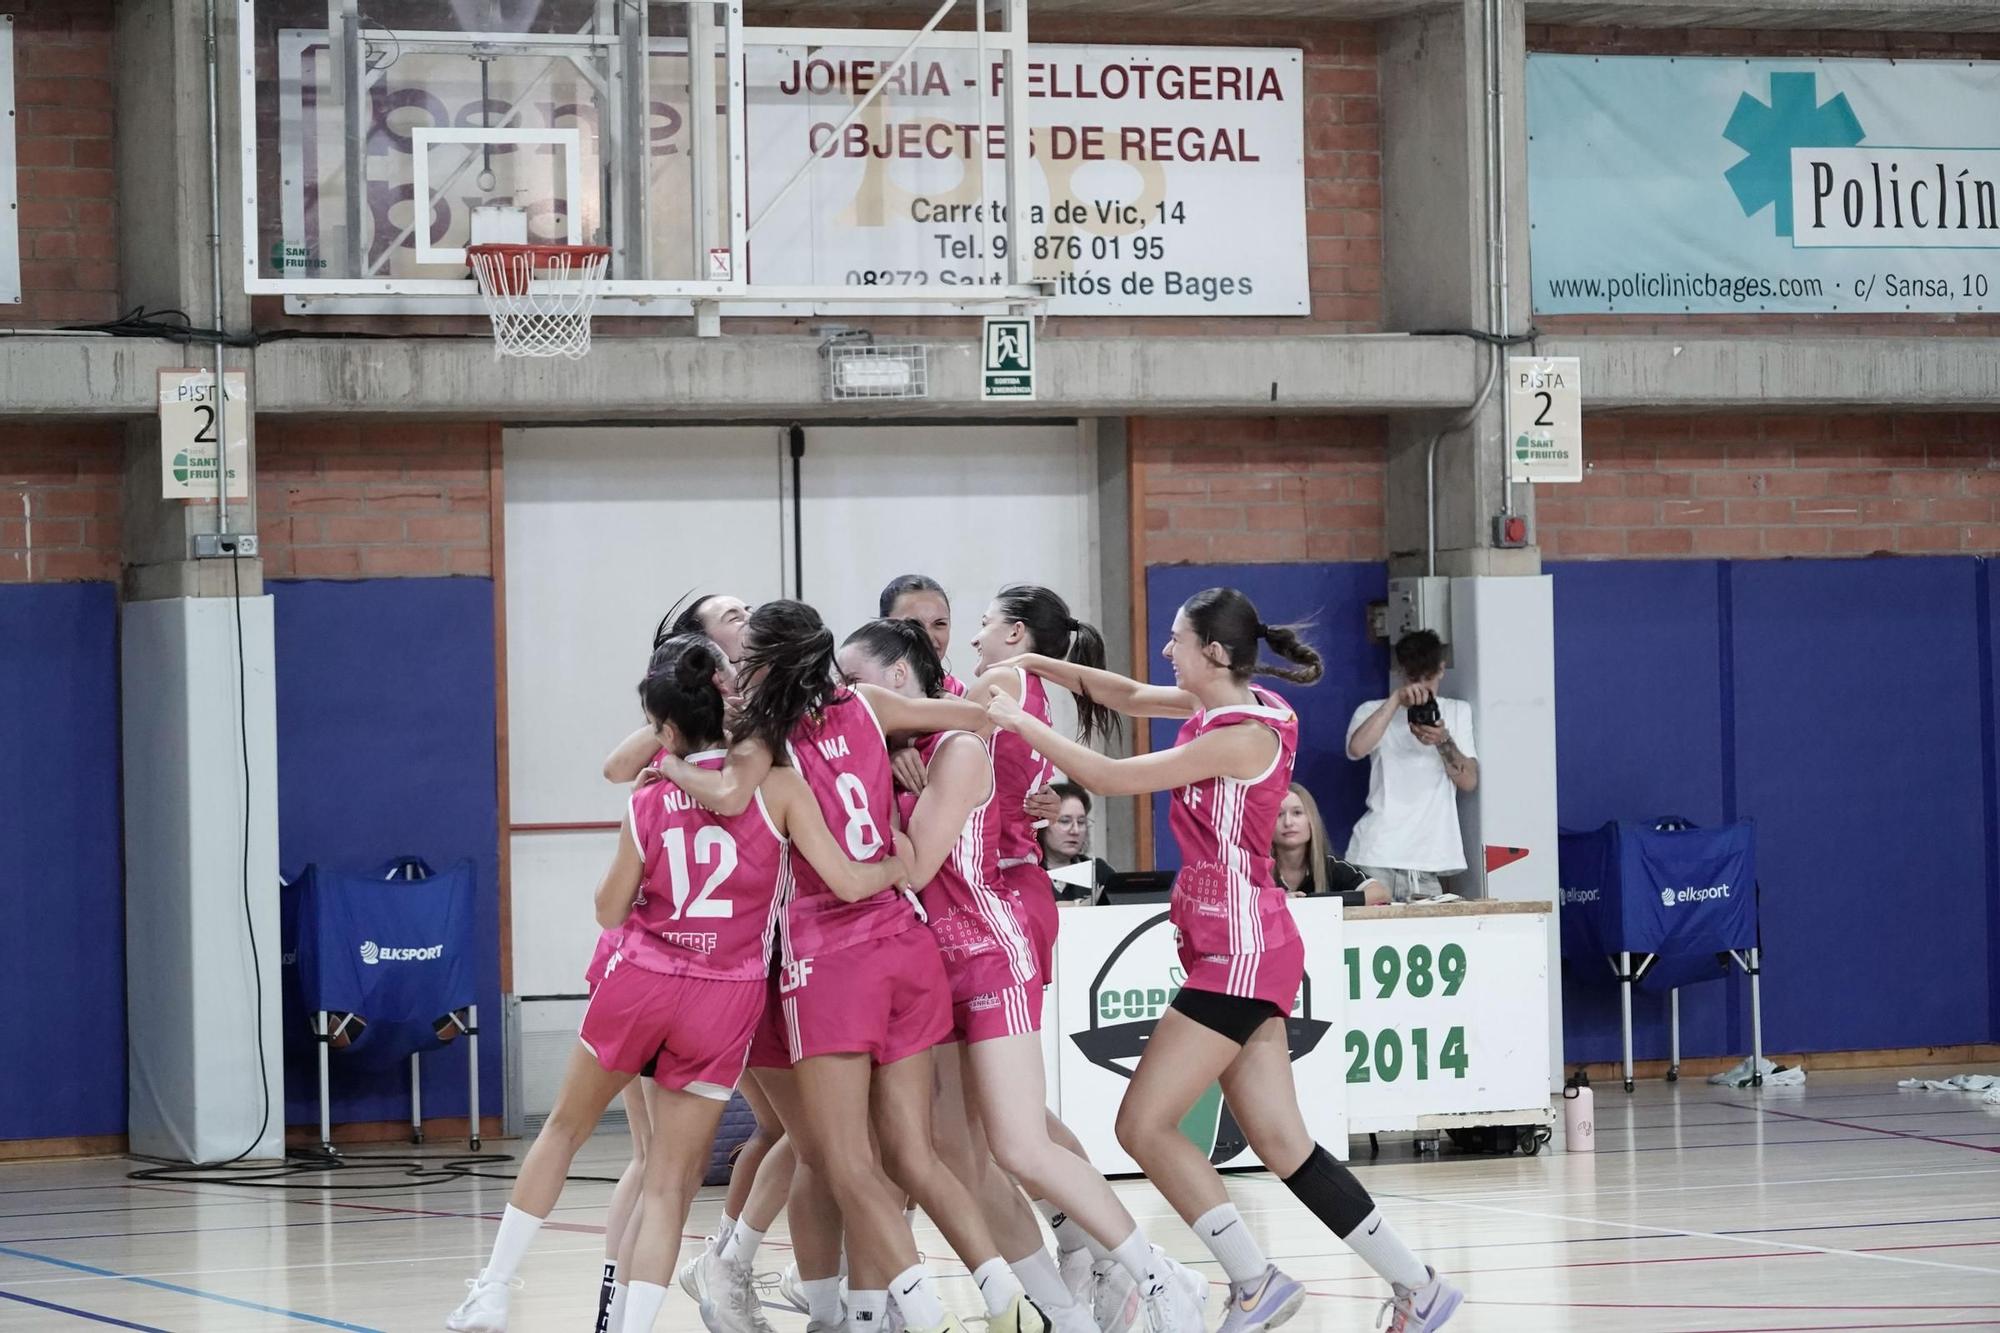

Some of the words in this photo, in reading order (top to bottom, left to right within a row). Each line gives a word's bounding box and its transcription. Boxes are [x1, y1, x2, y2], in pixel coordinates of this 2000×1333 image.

[780, 59, 951, 96] JOIERIA
[809, 121, 1036, 159] OBJECTE
[1051, 126, 1105, 160] DE
[1121, 127, 1260, 162] REGAL
[1054, 200, 1087, 224] de
[1095, 200, 1146, 229] Vic,
[1155, 201, 1187, 225] 14
[934, 234, 983, 259] Tel.
[1034, 235, 1082, 260] 876
[1092, 236, 1120, 260] 01
[1133, 236, 1164, 260] 95
[1121, 272, 1154, 295] de
[1165, 272, 1254, 302] Bages
[1549, 272, 1823, 303] www.policlinicbages.com
[1885, 273, 1954, 301] Sansa,
[1962, 274, 1989, 297] 10
[1520, 373, 1565, 389] PISTA
[194, 404, 218, 443] 2
[1534, 391, 1554, 426] 2
[1530, 440, 1554, 448] SANT
[189, 469, 235, 479] FRUITS
[836, 771, 884, 862] 8
[660, 825, 739, 921] 12
[1677, 883, 1730, 903] elksport
[1344, 943, 1467, 1000] 1989
[1344, 1026, 1469, 1084] 2014
